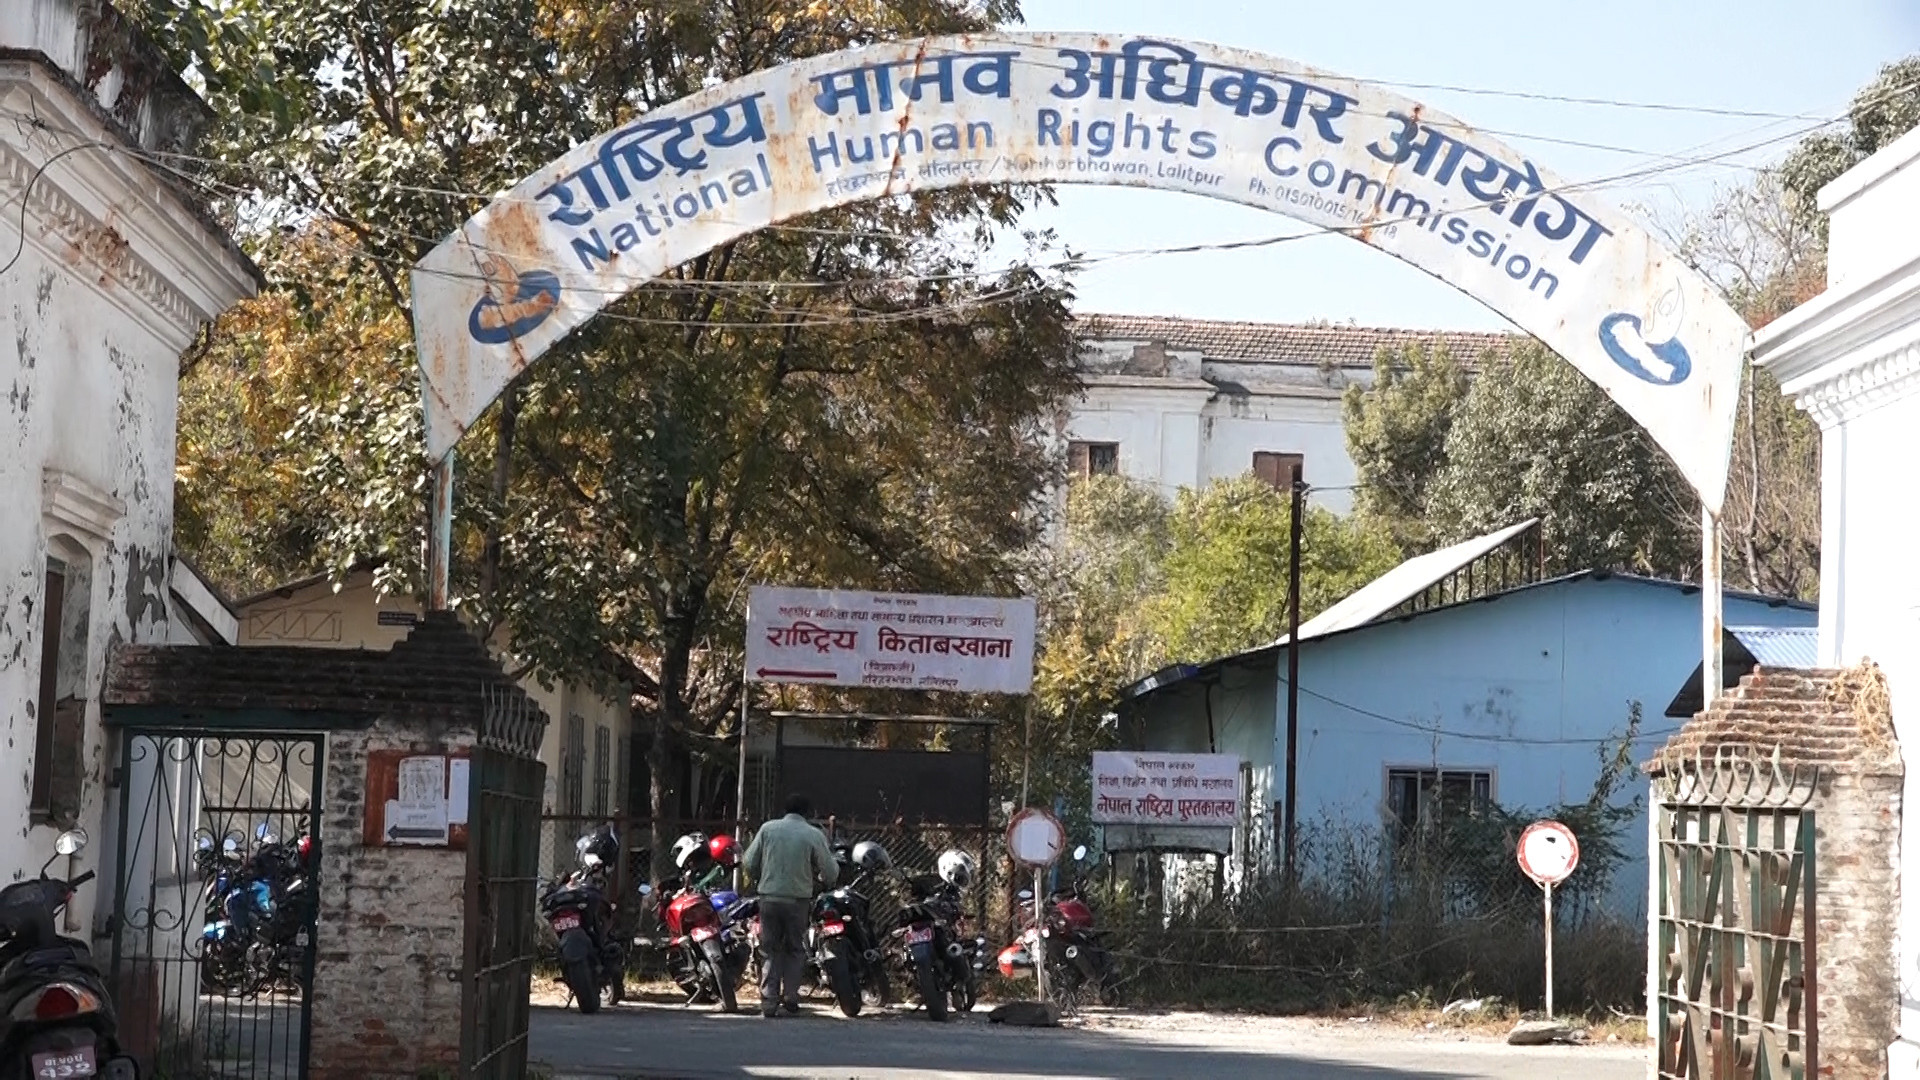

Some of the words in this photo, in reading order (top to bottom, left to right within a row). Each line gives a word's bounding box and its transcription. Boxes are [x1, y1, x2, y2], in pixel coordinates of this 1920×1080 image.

[535, 91, 767, 226] राष्ट्रिय
[811, 52, 1020, 116] मानव
[1050, 40, 1360, 144] अधिकार
[1366, 109, 1614, 264] आयोग
[1157, 161, 1224, 187] Lalitpur
[570, 153, 772, 270] National
[808, 118, 994, 174] Human
[1037, 107, 1218, 159] Rights
[1264, 136, 1560, 300] Commission
[766, 621, 858, 654] राष्ट्रिय
[878, 626, 1013, 659] किताबखाना
[1097, 793, 1132, 815] नेपाल
[1135, 793, 1175, 819] राष्ट्रिय
[1177, 798, 1236, 822] पुस्तकालय
